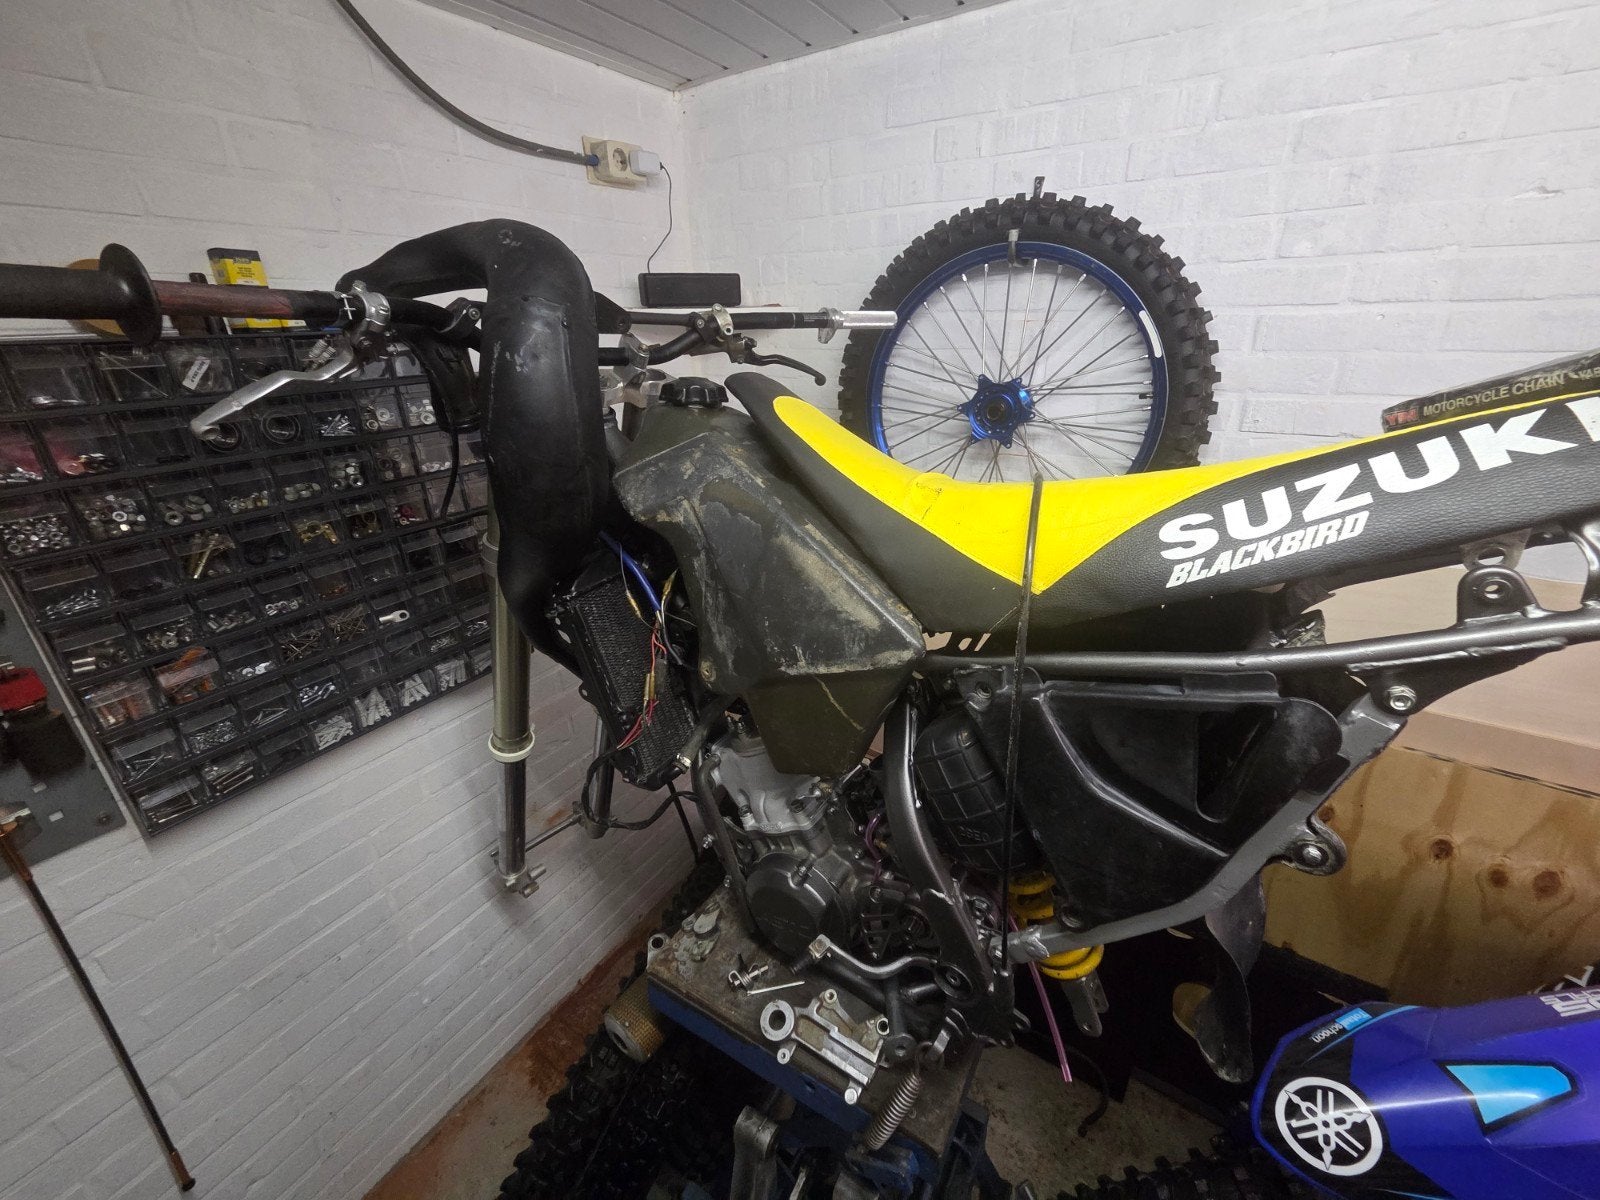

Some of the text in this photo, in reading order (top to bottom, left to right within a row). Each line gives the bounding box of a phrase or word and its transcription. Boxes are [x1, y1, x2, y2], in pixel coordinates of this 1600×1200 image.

[1423, 386, 1510, 416] MOTORCYCLE
[1511, 370, 1567, 396] CHAIN
[1166, 510, 1370, 589] BLACKBIRD
